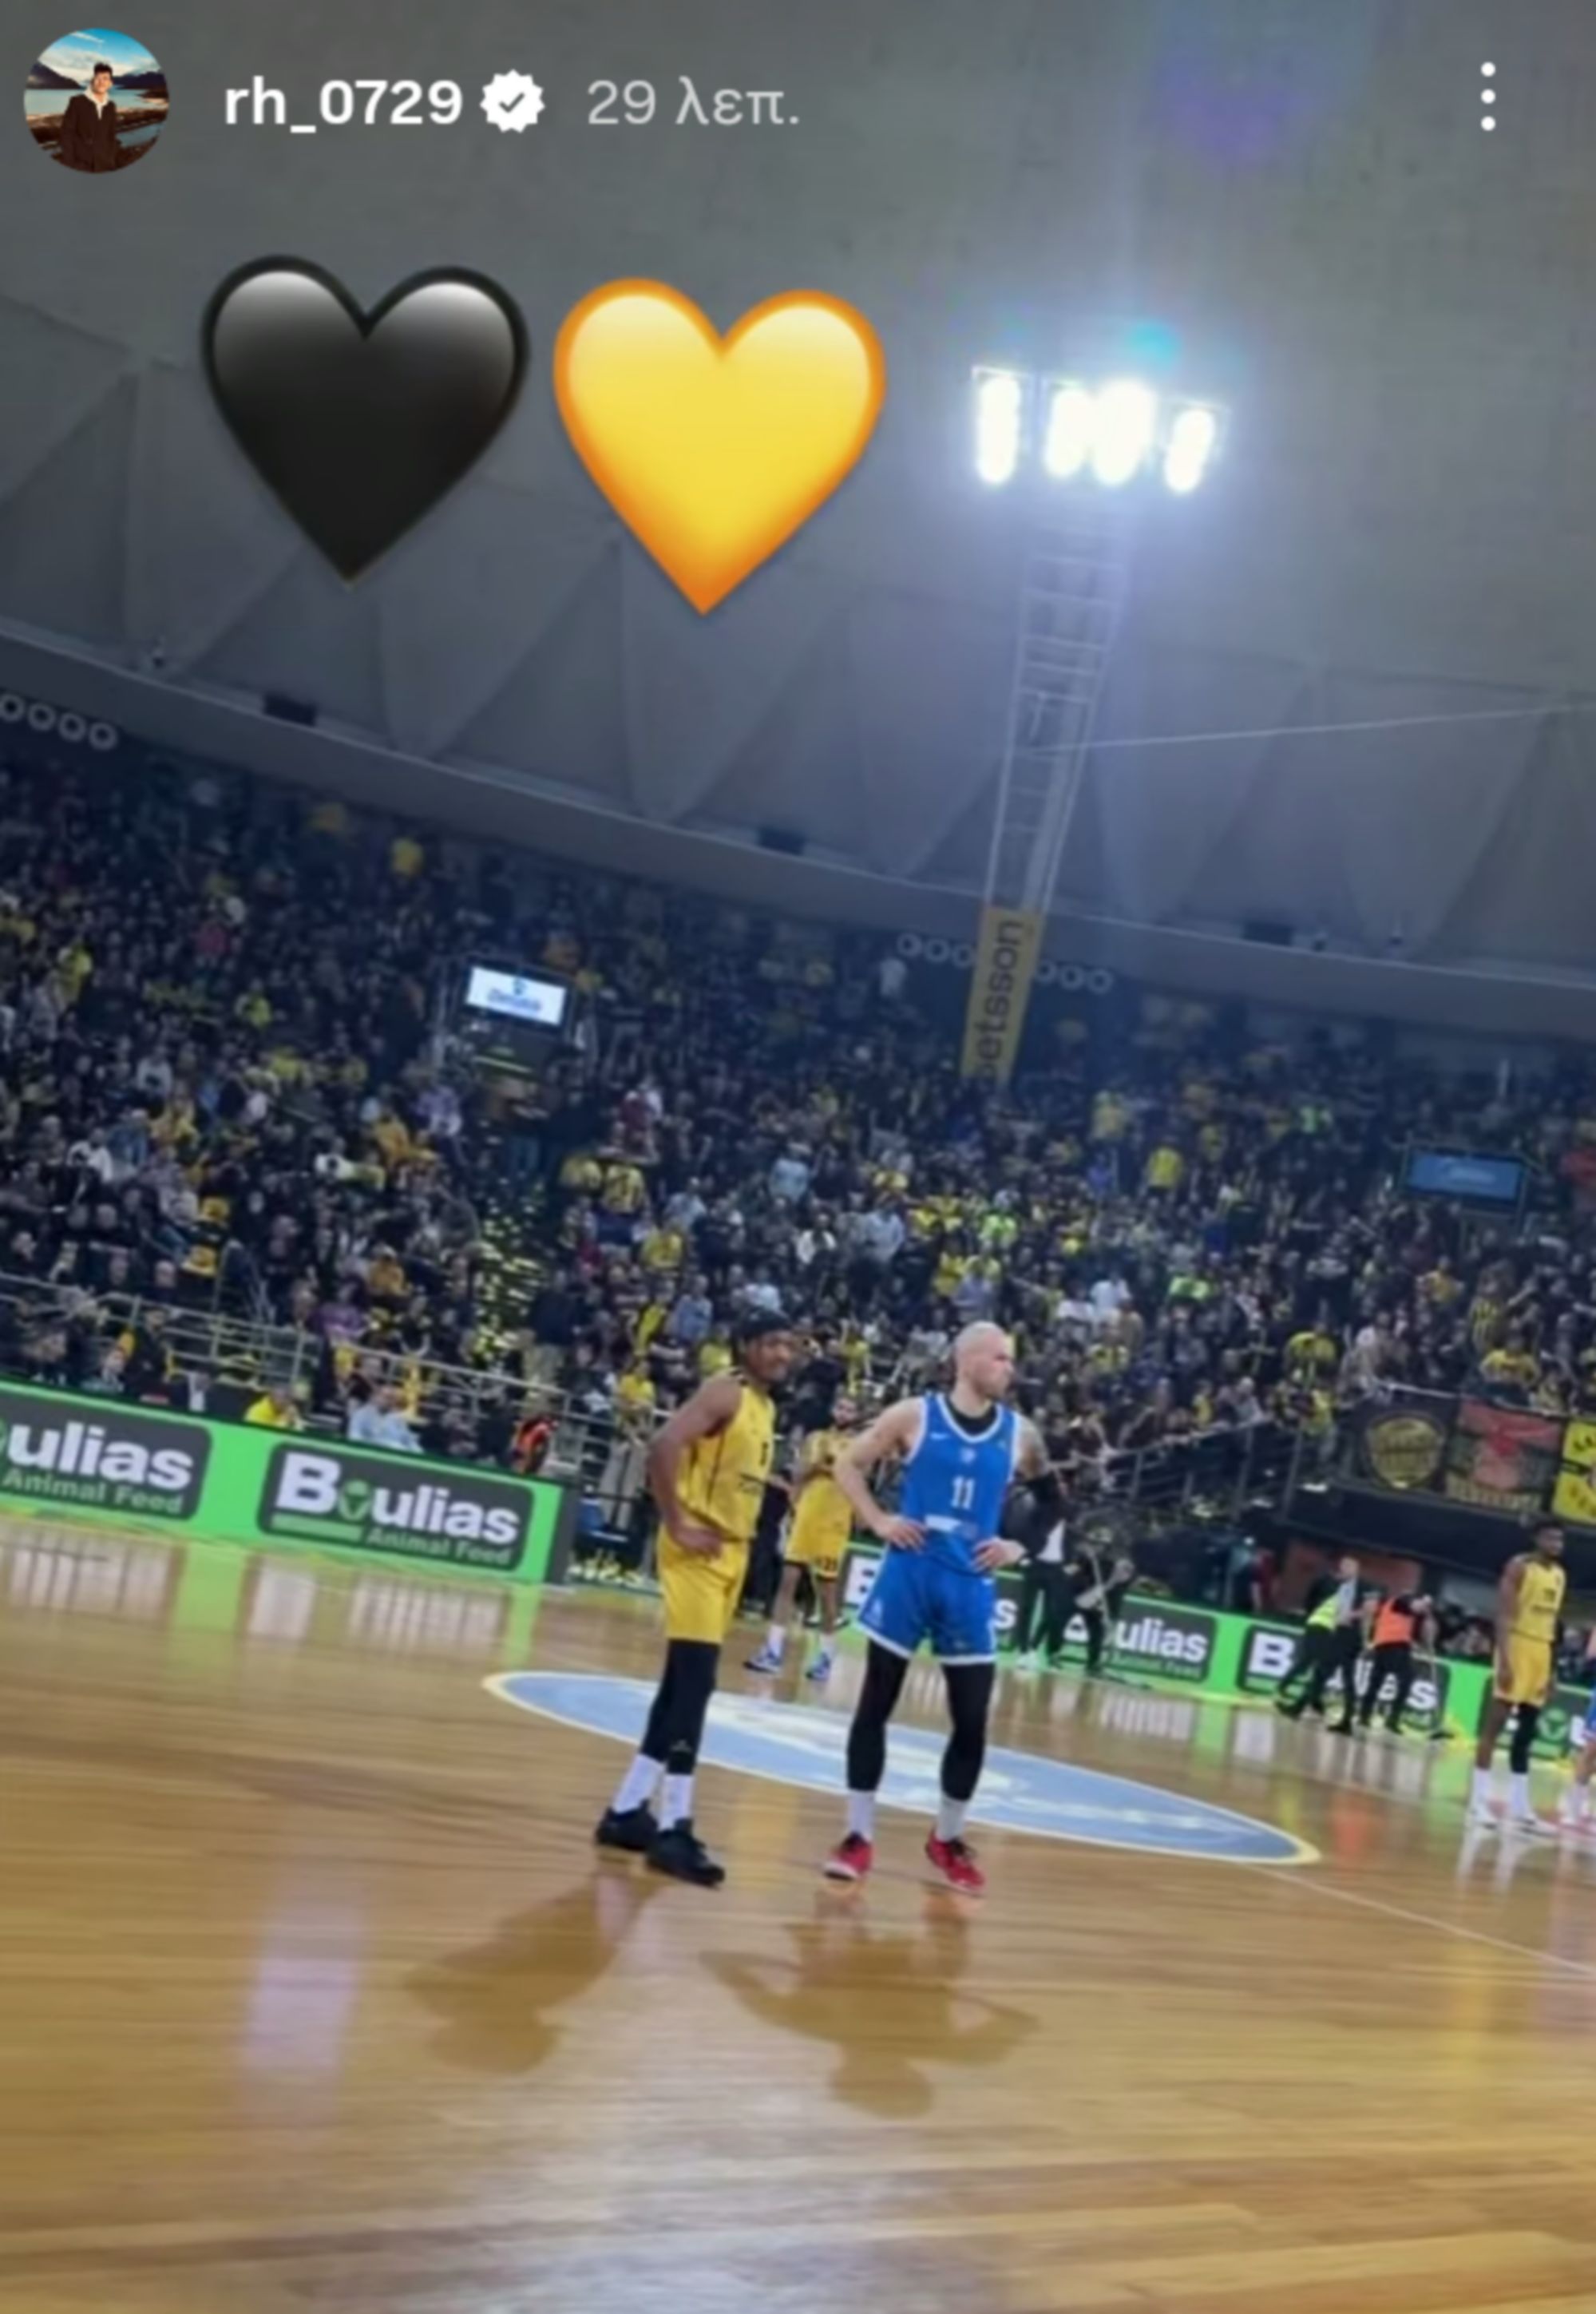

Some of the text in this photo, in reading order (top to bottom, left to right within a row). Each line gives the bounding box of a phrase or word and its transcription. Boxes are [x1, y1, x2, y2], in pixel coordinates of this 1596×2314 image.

[5, 1420, 194, 1491] ulias
[1, 1467, 184, 1515] Animal Feed
[949, 1476, 975, 1509] 11
